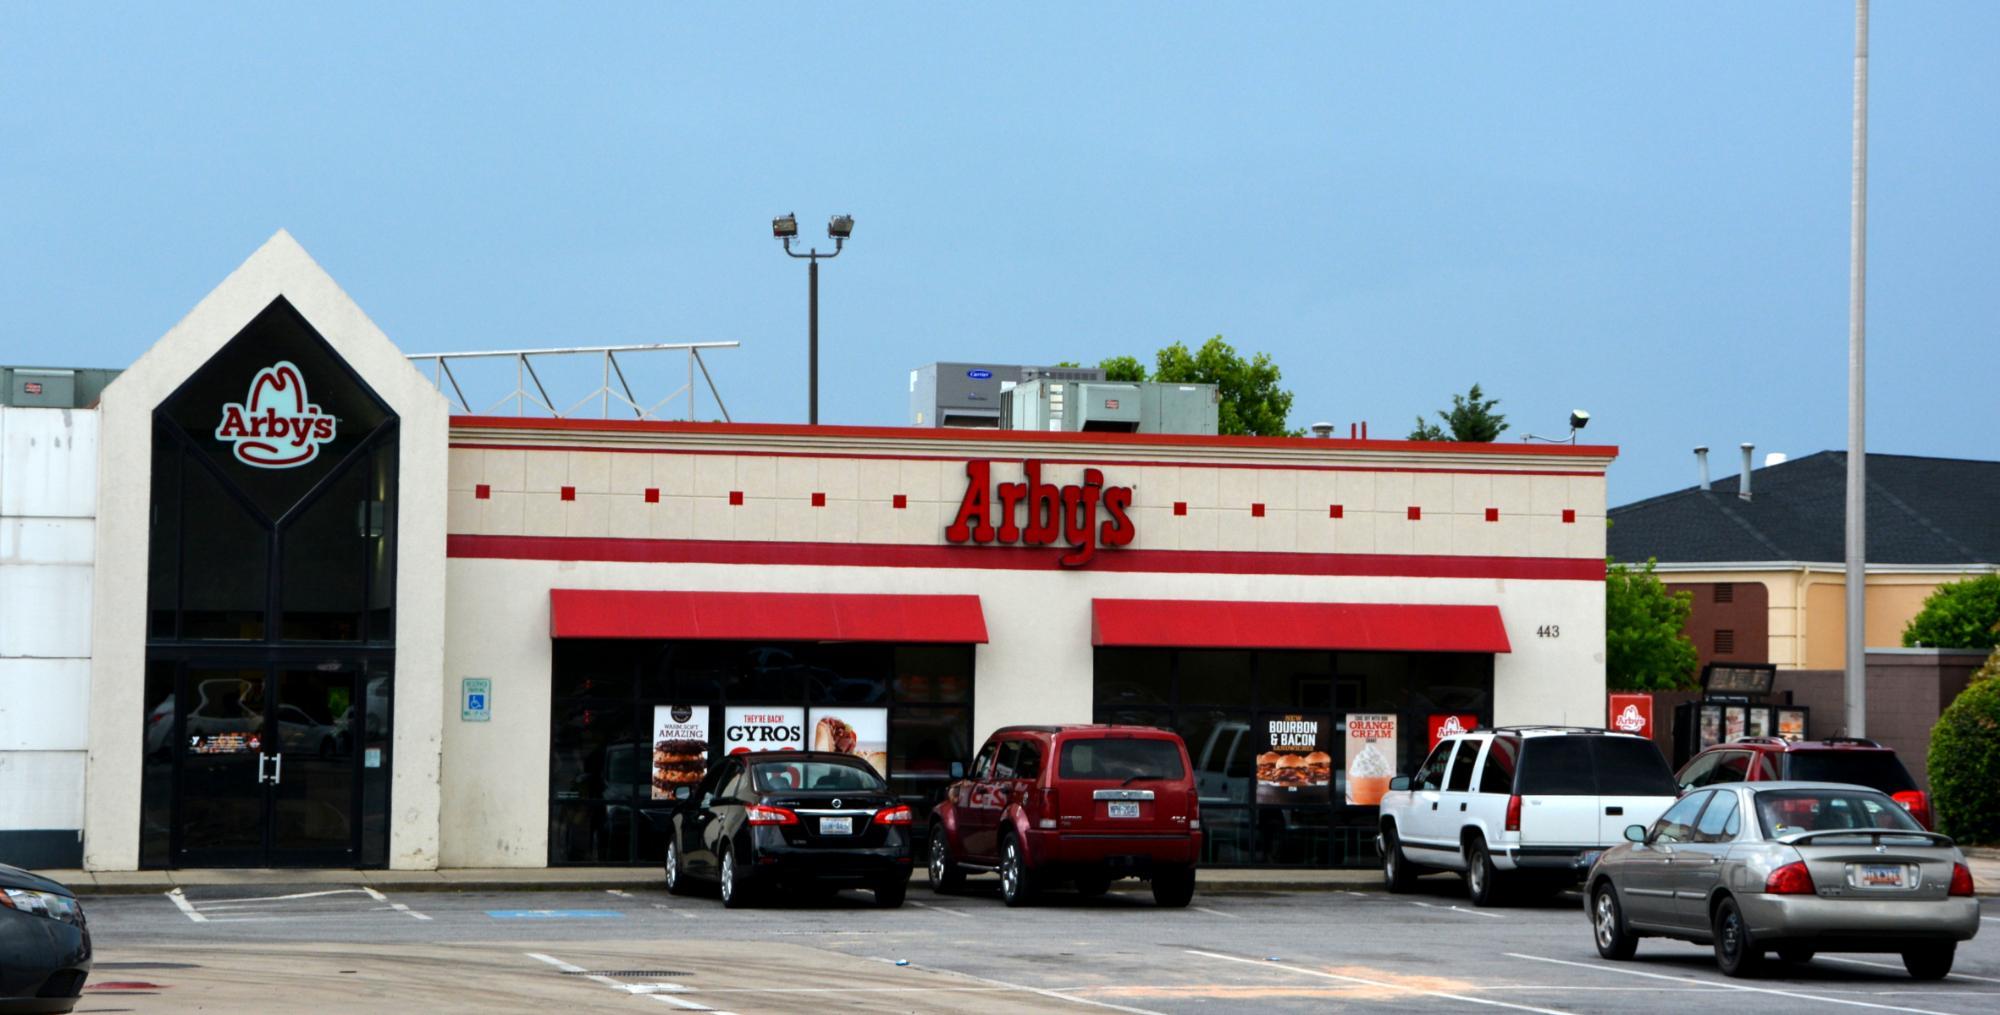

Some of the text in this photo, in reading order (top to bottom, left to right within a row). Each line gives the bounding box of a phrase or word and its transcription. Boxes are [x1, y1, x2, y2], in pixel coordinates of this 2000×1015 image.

[220, 406, 333, 447] Arby's
[945, 458, 1136, 568] Arby's
[1536, 624, 1560, 638] 443
[744, 714, 785, 723] THEY'RE BACK!
[1349, 720, 1394, 730] ORANGE
[726, 725, 801, 742] GYROS
[1269, 720, 1318, 734] BOURBON
[658, 729, 704, 739] AMAZING
[1270, 733, 1316, 746] & BACON
[1351, 729, 1392, 739] CREAM
